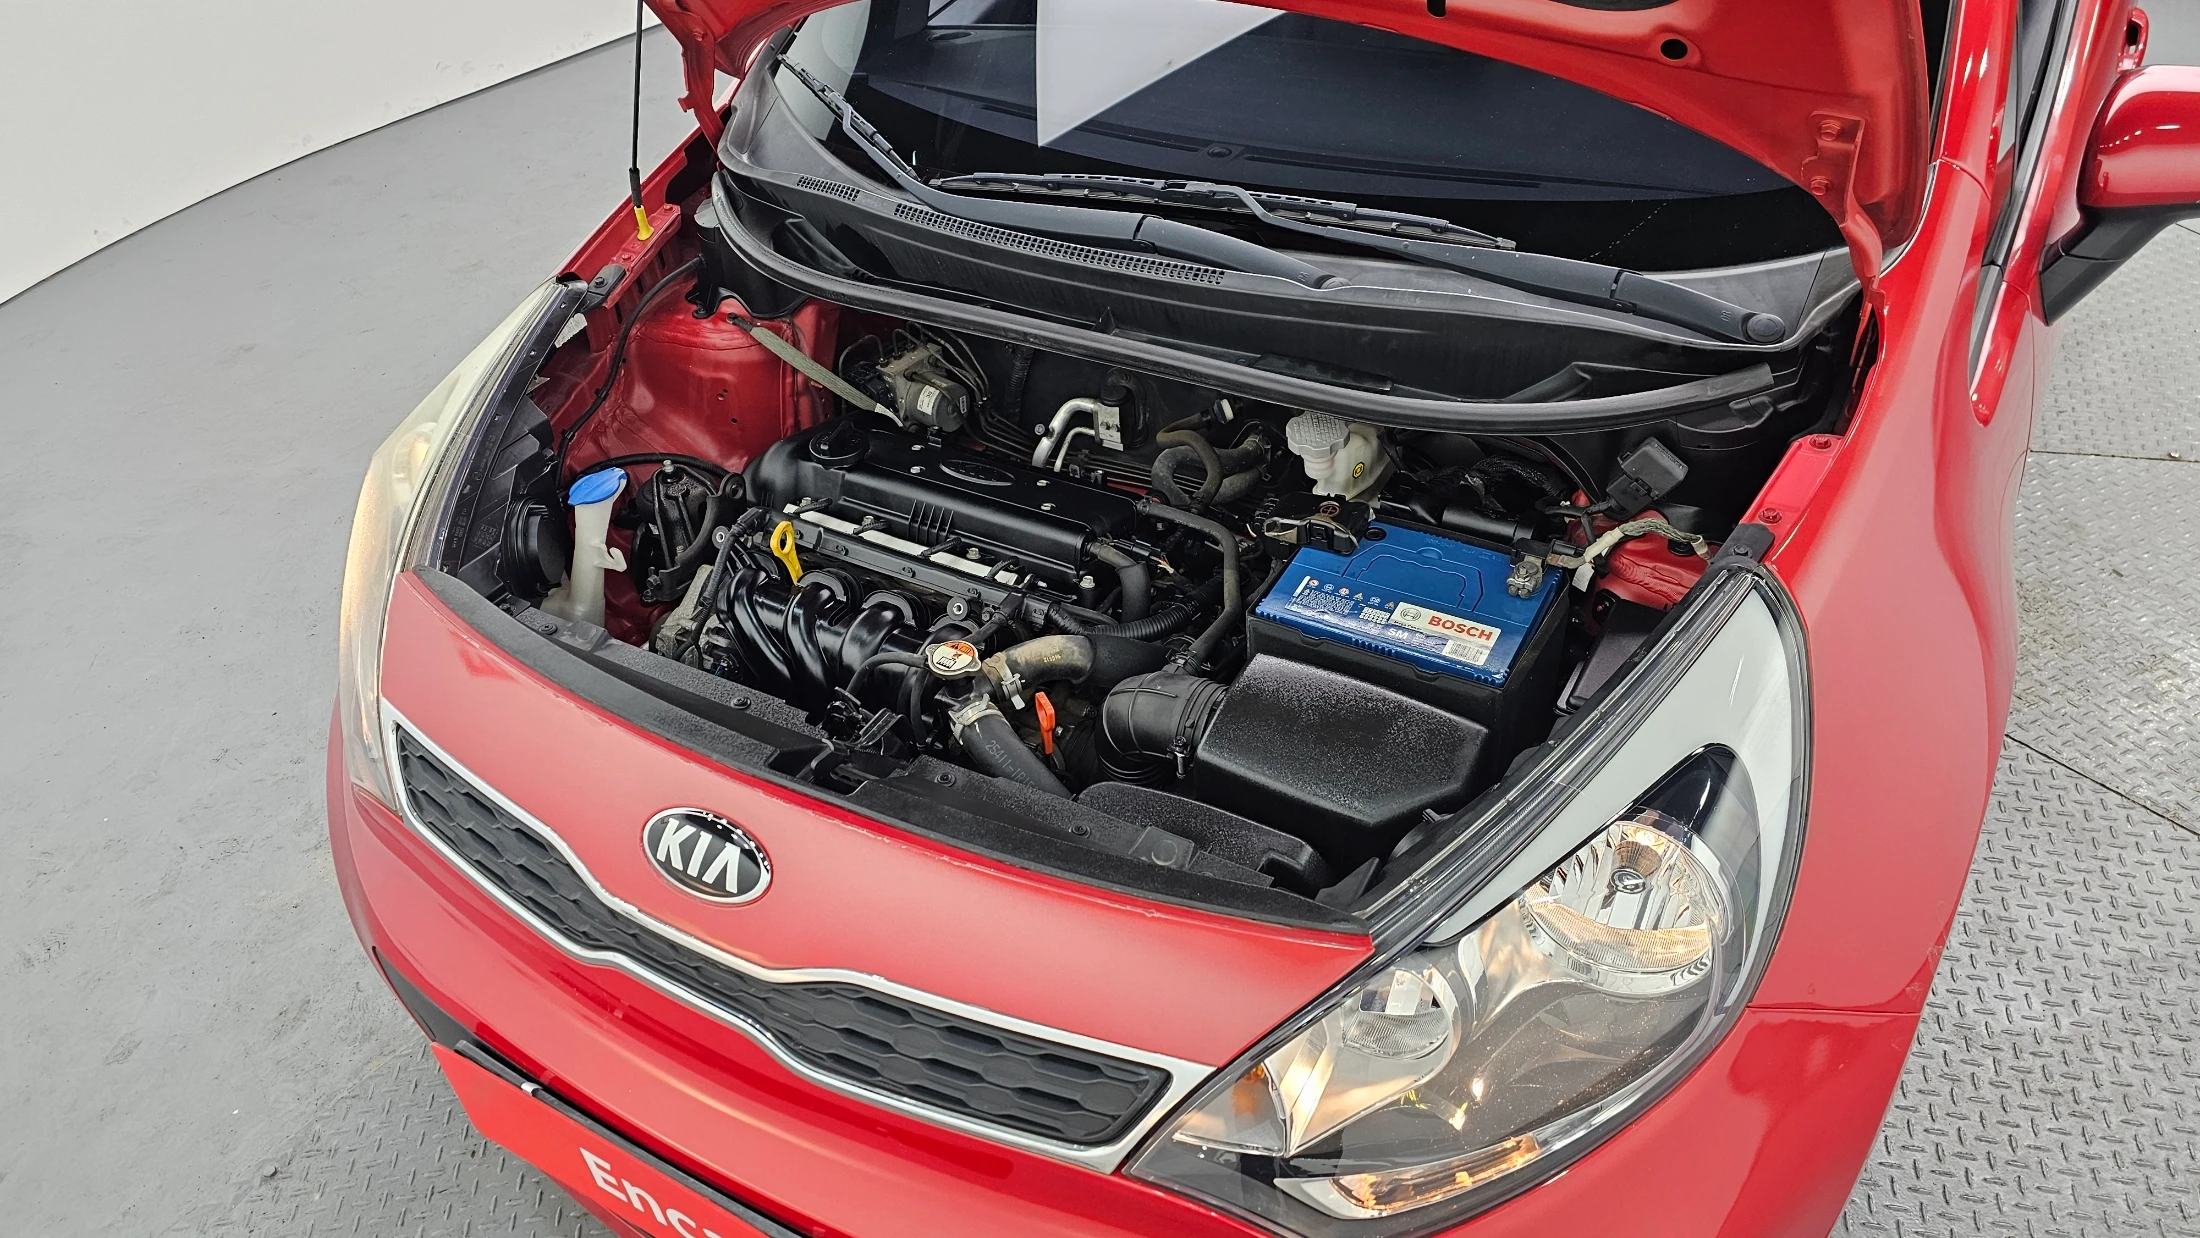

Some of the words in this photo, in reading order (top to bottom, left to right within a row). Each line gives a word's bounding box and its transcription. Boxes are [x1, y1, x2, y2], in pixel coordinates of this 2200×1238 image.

[1387, 628, 1409, 640] SM
[1428, 615, 1493, 642] BOSCH
[656, 817, 741, 894] KIA
[579, 1146, 722, 1238] Enc
